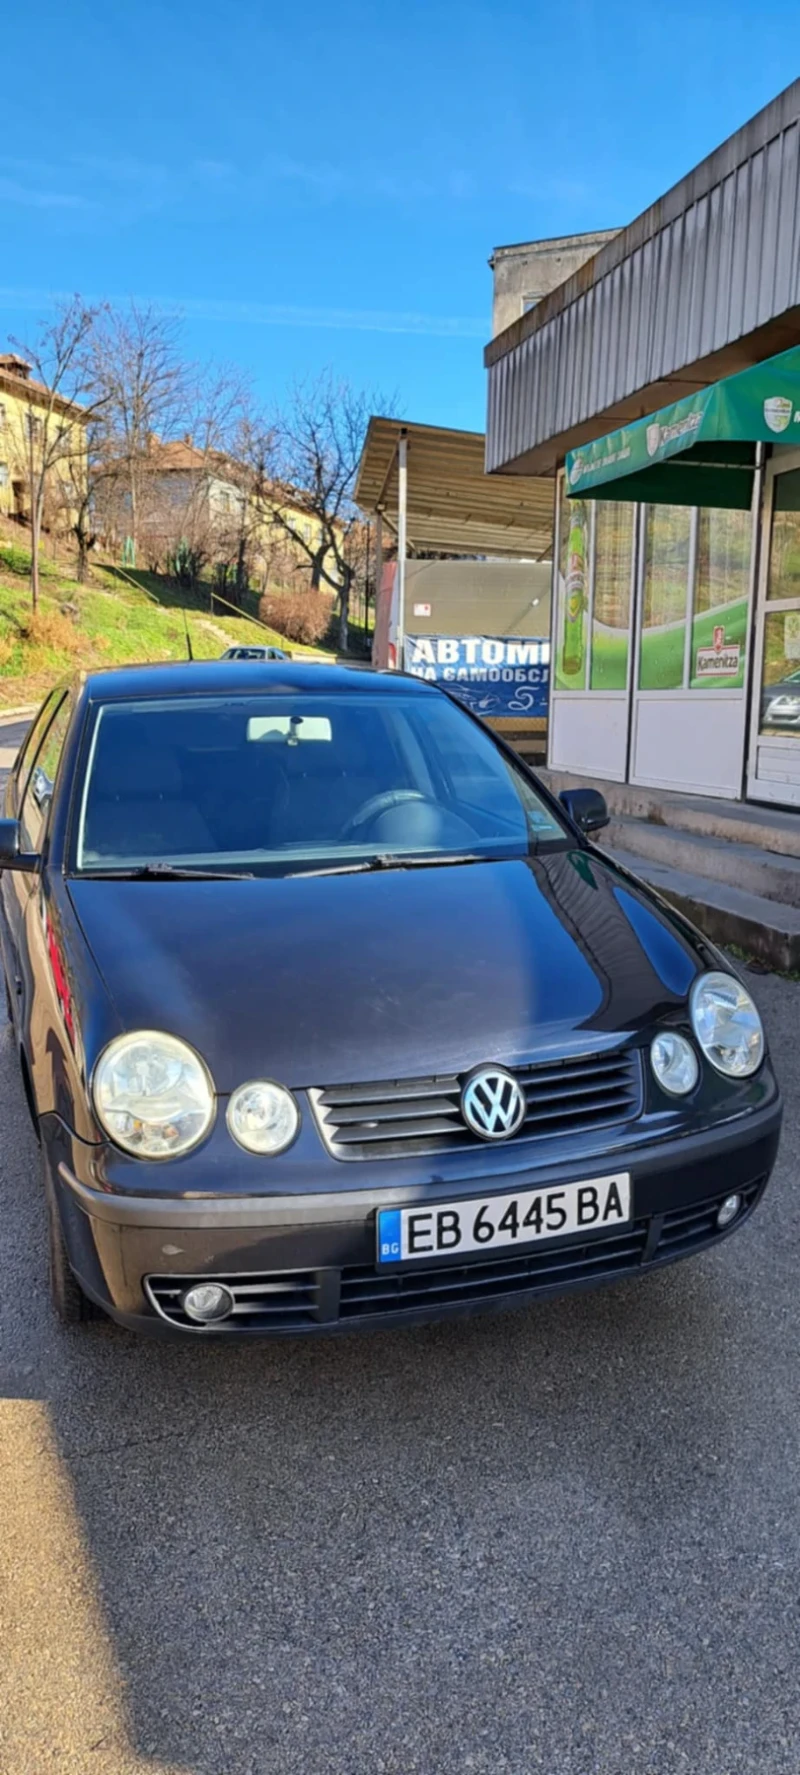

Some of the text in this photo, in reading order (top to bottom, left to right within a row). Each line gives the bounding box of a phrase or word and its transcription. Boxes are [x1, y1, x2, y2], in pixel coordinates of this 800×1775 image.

[697, 654, 739, 671] Kamenitza
[407, 1181, 623, 1254] EB 6445 BA
[381, 1242, 399, 1256] BG
